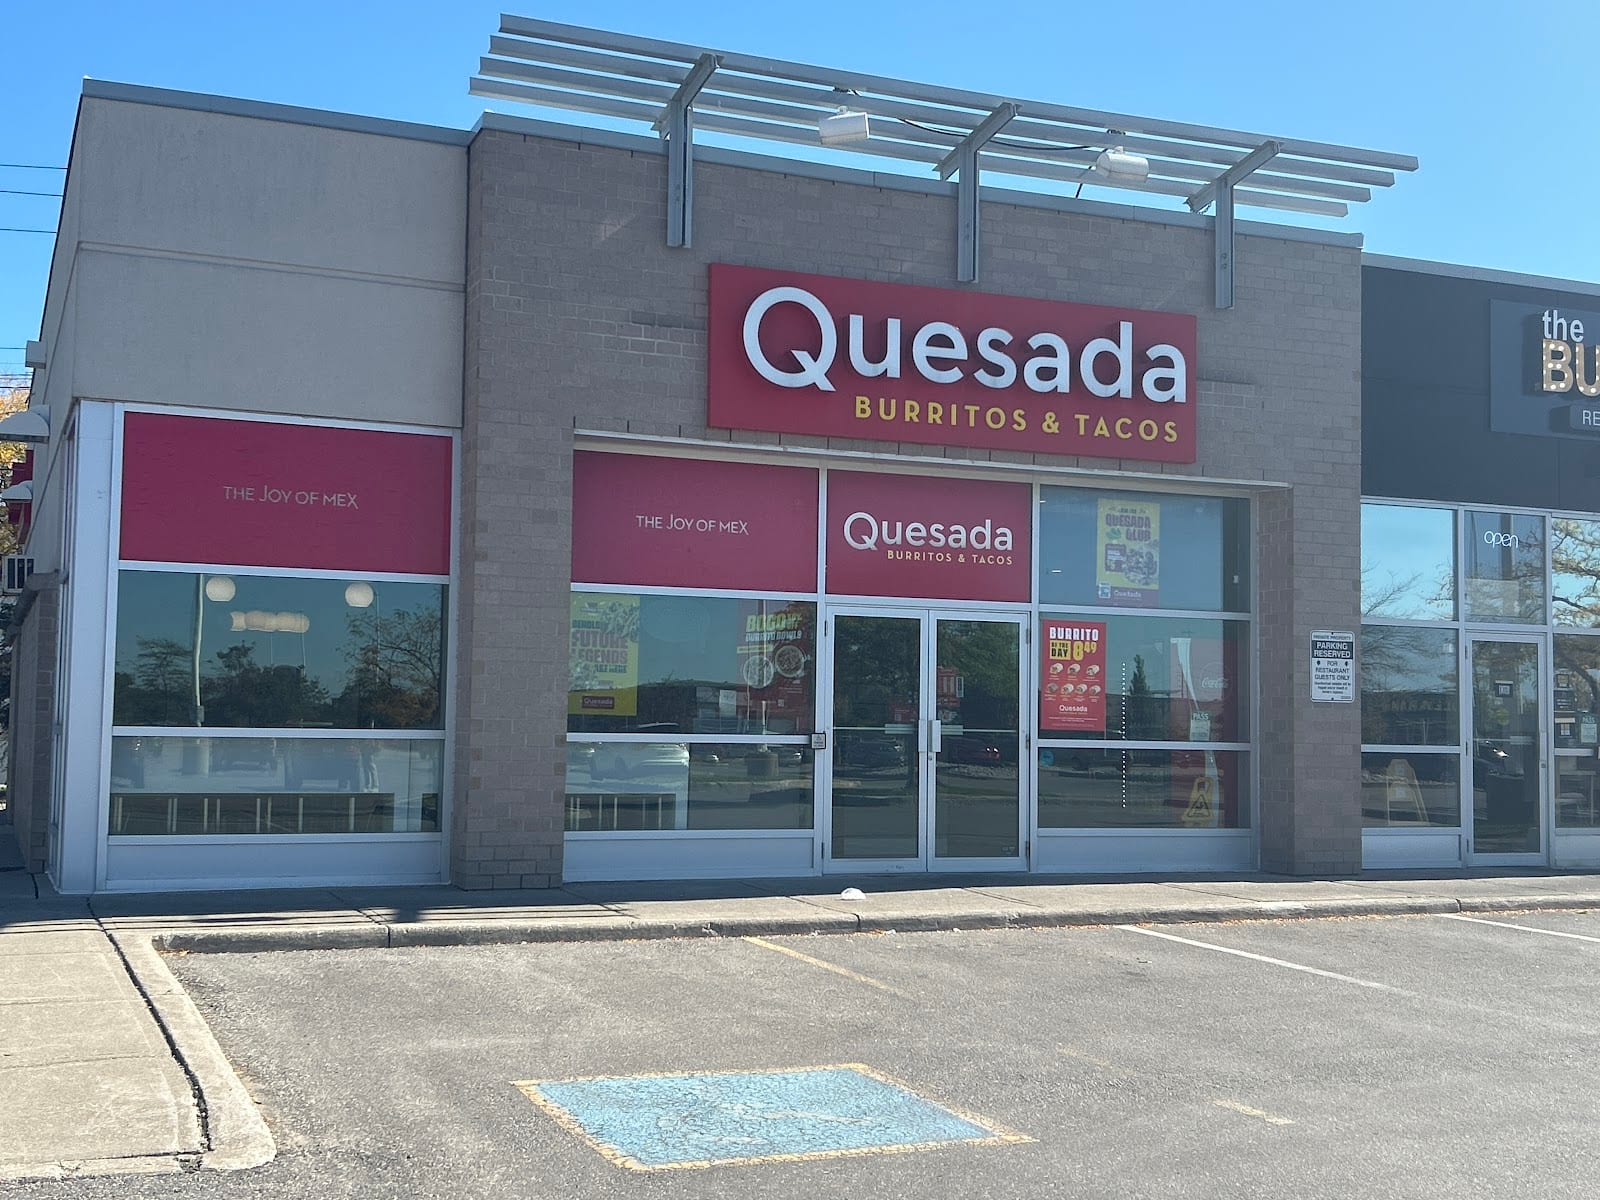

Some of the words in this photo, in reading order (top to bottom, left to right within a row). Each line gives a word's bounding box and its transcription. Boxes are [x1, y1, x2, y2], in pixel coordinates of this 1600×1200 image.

[1542, 309, 1584, 343] the
[742, 286, 1187, 404] Quesada
[855, 395, 1027, 432] BURRITOS
[1041, 411, 1061, 435] &
[1074, 414, 1179, 443] TACOS
[223, 485, 255, 501] THE
[259, 484, 292, 503] JOY
[295, 491, 319, 505] OF
[322, 492, 360, 510] MEX
[635, 514, 663, 529] THE
[666, 513, 694, 531] JOY
[696, 519, 717, 532] OF
[719, 520, 750, 536] MEX
[1105, 513, 1151, 529] QUESADA
[843, 511, 1014, 551] Quesada
[1125, 527, 1151, 541] CLUB
[1484, 530, 1519, 549] open
[887, 549, 952, 562] BURRITOS
[957, 553, 966, 563] &
[972, 554, 1013, 565] TACOS
[1049, 626, 1099, 641] BURRITO
[1051, 648, 1068, 657] DAY
[1313, 649, 1351, 658] RESERVED
[1316, 641, 1348, 650] PARKING
[1059, 704, 1088, 712] Quesada
[1192, 711, 1209, 720] PASS
